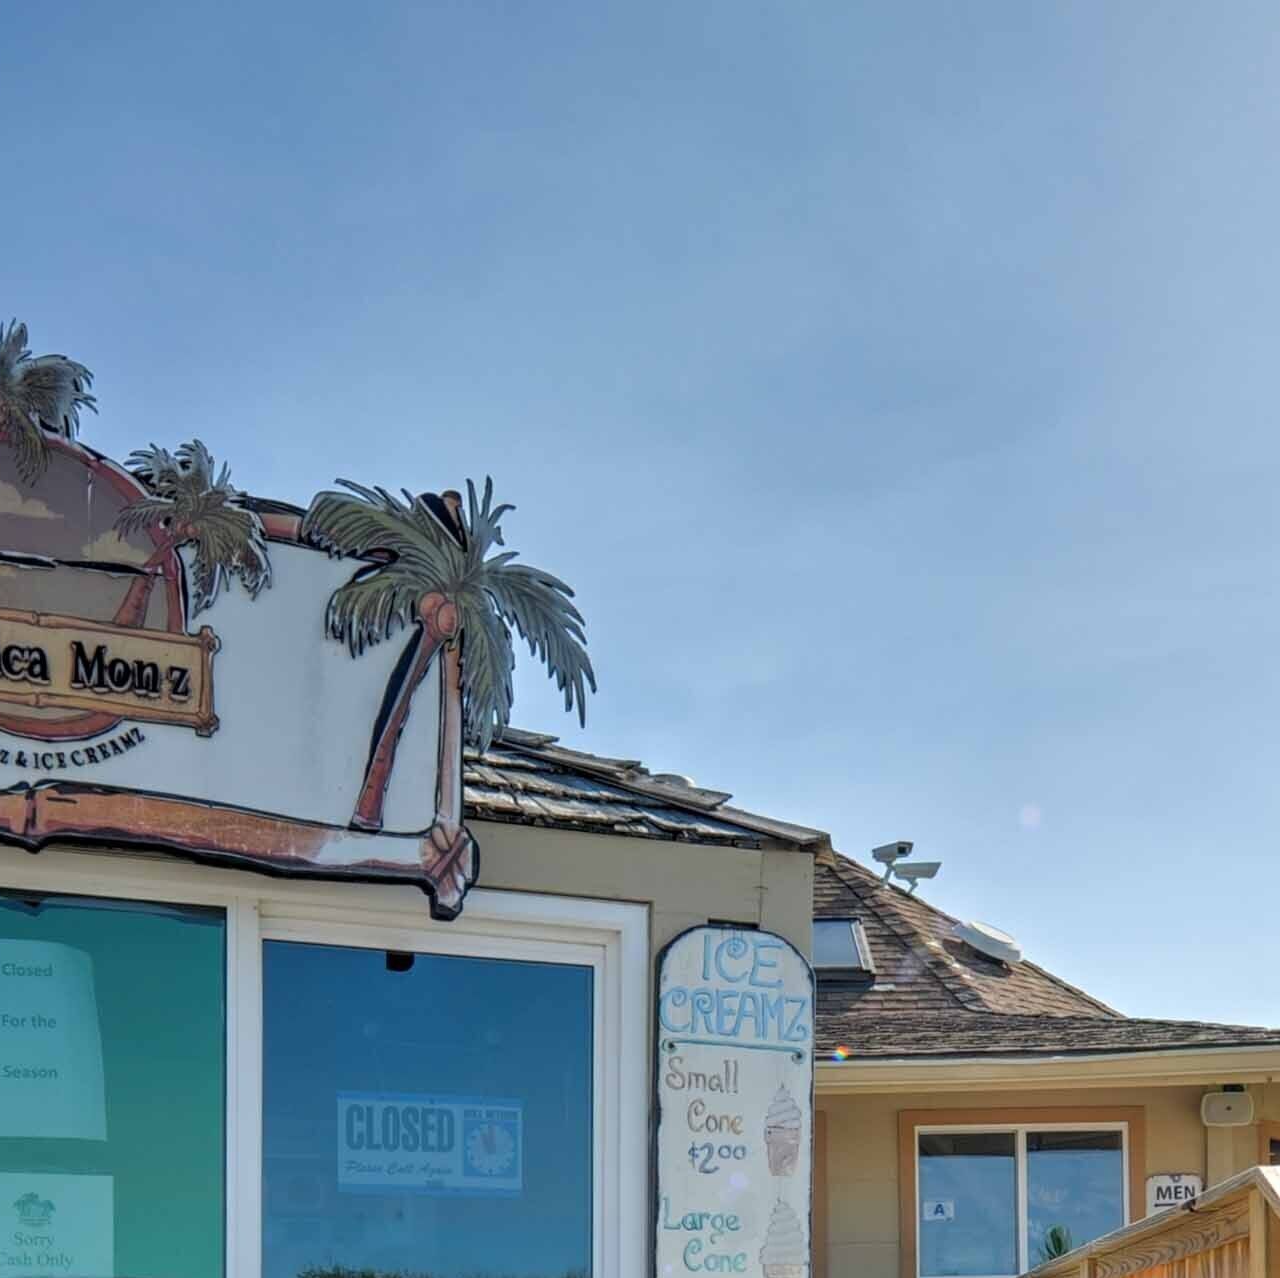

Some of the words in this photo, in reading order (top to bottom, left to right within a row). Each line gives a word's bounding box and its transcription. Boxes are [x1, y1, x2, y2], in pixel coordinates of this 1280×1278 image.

[15, 751, 28, 768] &
[33, 752, 67, 770] ICE
[71, 727, 146, 767] CREAMZ
[1, 962, 53, 977] Closed
[702, 935, 784, 989] ICE
[1, 1014, 26, 1027] For
[31, 1014, 57, 1029] the
[660, 987, 809, 1042] CREAMZ
[1, 1065, 58, 1080] Season
[665, 1056, 738, 1094] Small
[345, 1104, 455, 1152] CLOSED
[687, 1098, 744, 1135] Cone
[343, 1160, 384, 1175] Please
[1156, 1185, 1195, 1200] MEN
[662, 1196, 741, 1244] Large
[934, 1204, 945, 1216] A
[14, 1232, 55, 1250] Sorry
[37, 1252, 74, 1271] Only
[683, 1238, 747, 1272] Cone
